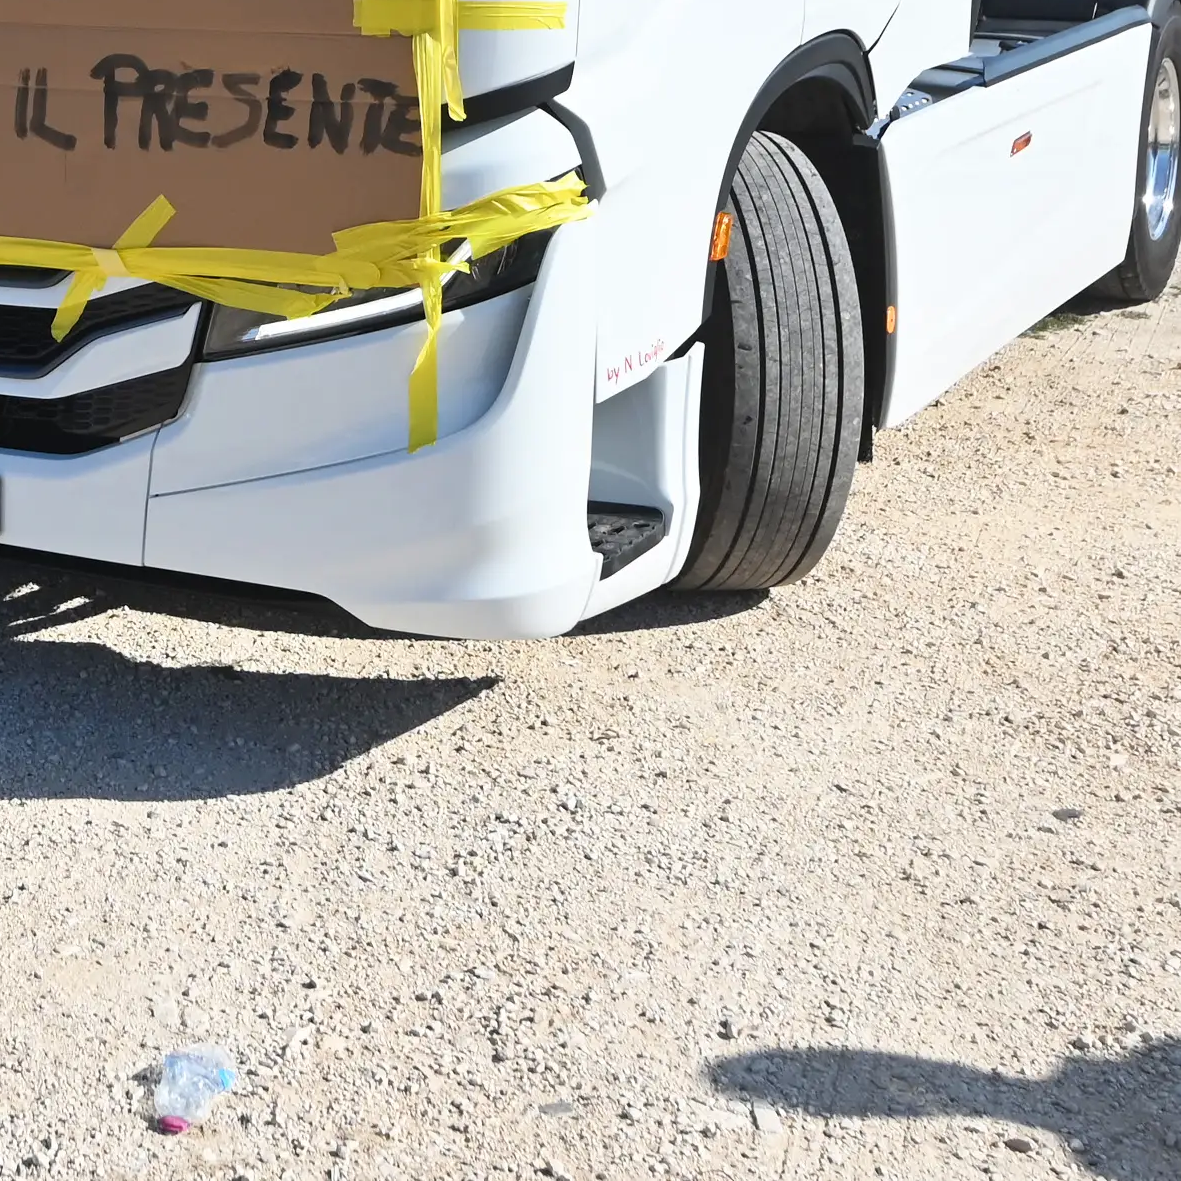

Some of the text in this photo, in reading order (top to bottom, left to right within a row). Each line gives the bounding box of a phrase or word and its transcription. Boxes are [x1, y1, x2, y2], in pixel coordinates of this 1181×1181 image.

[14, 66, 77, 151] IL
[90, 53, 423, 157] PRESENTE
[607, 367, 620, 385] by
